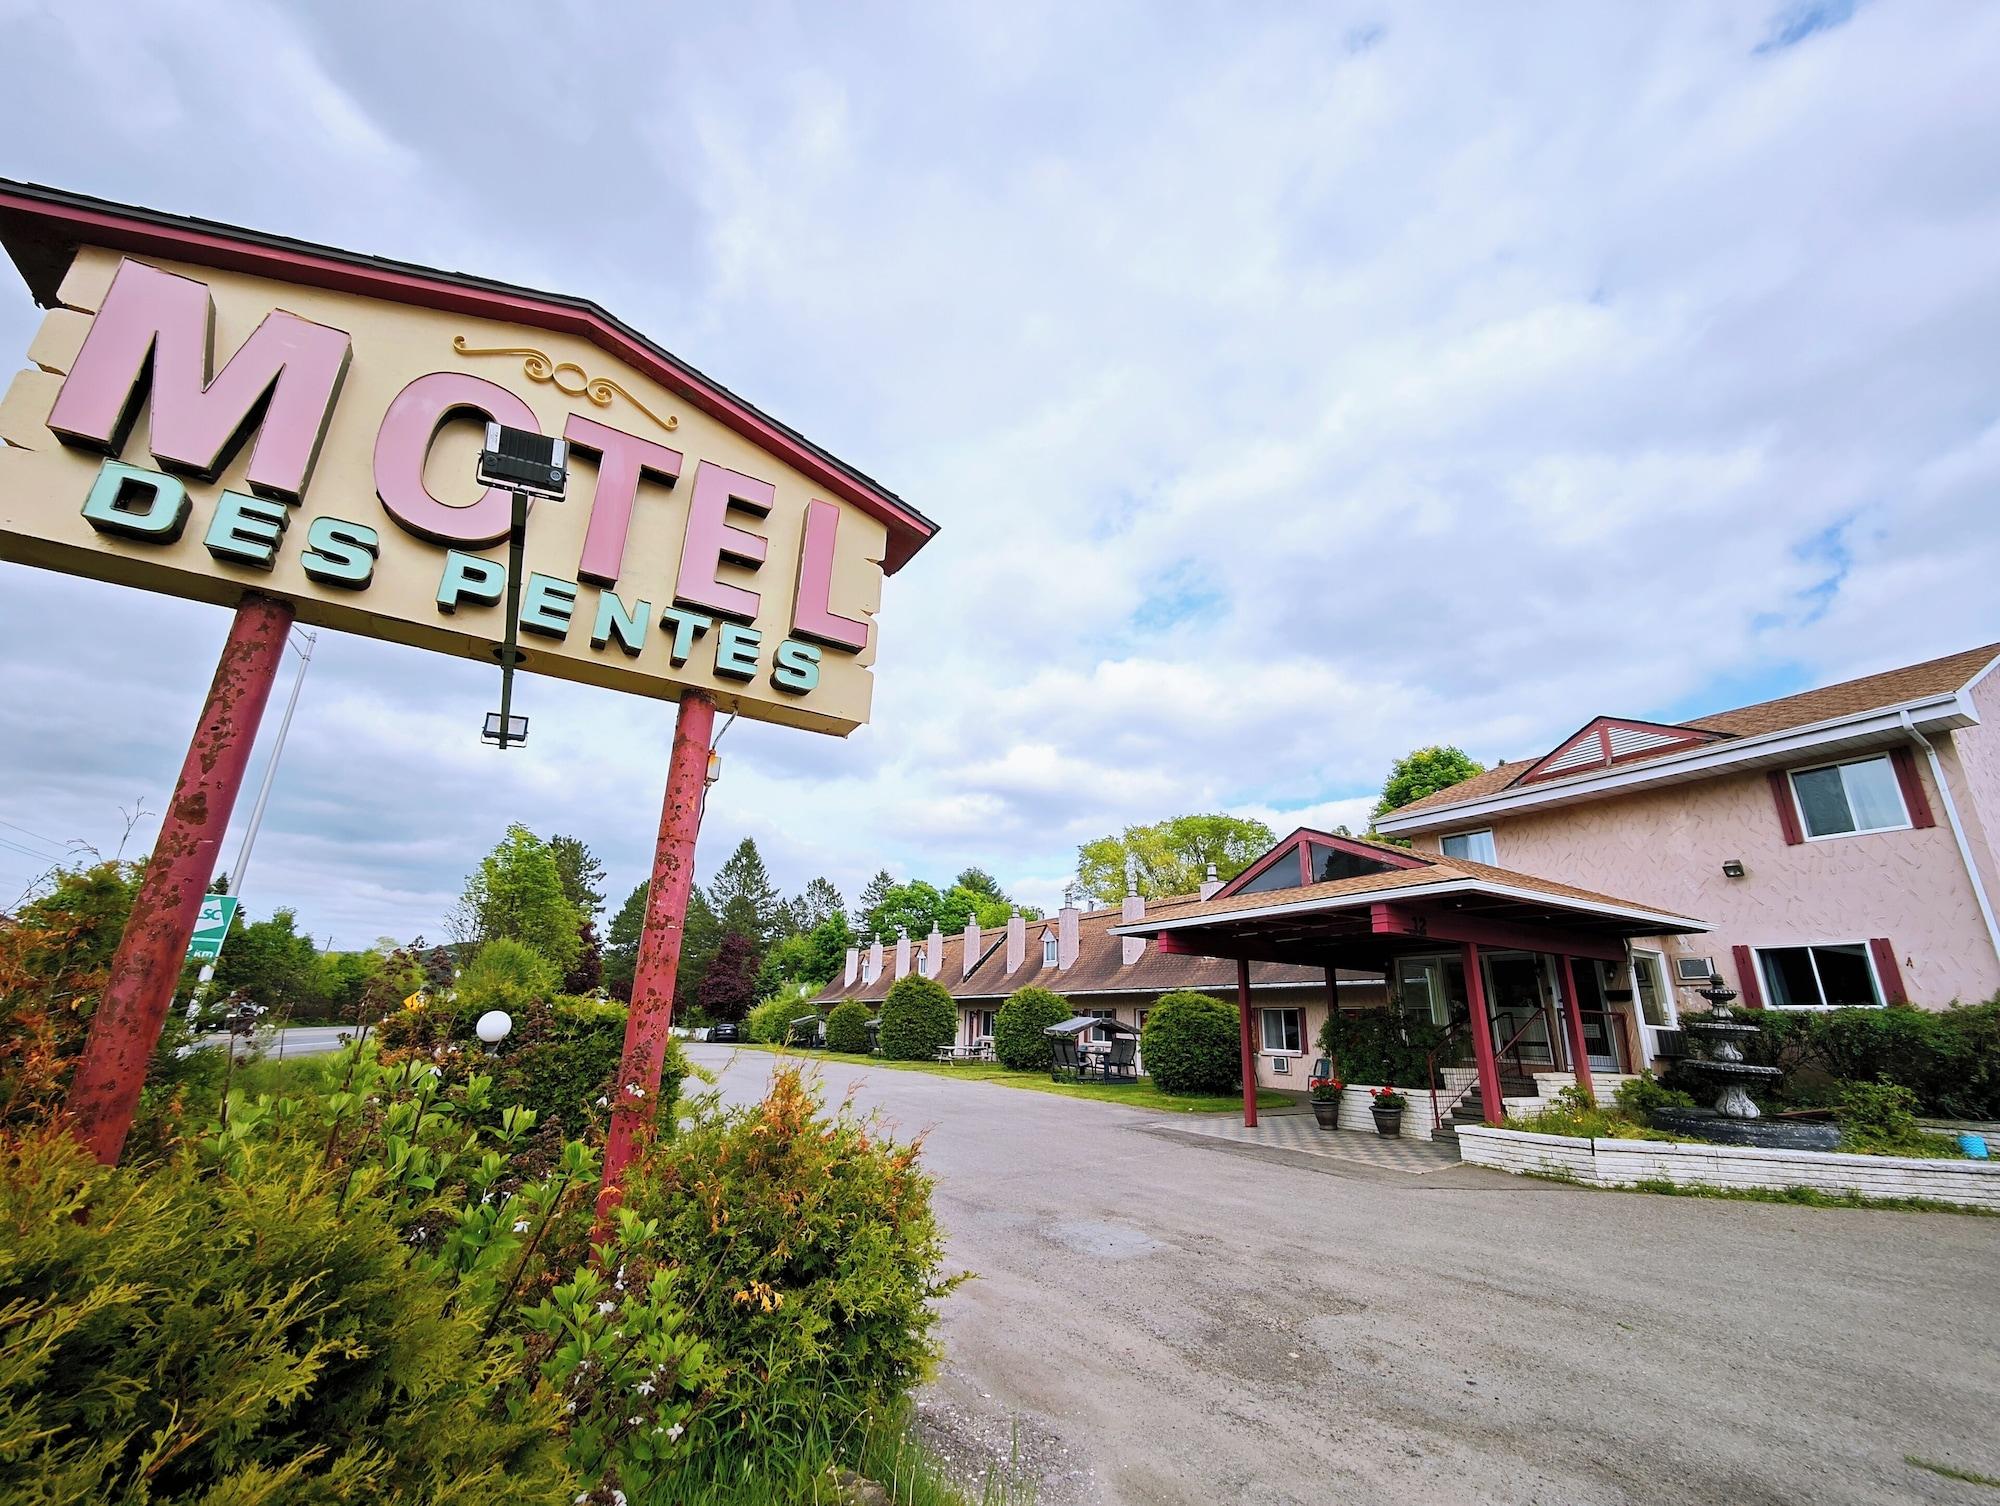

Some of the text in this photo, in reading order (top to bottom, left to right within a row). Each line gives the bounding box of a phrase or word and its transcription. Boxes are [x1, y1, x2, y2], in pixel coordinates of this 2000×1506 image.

[47, 257, 869, 651] MOTEL
[81, 458, 822, 694] DES PENTES
[198, 909, 222, 920] SC
